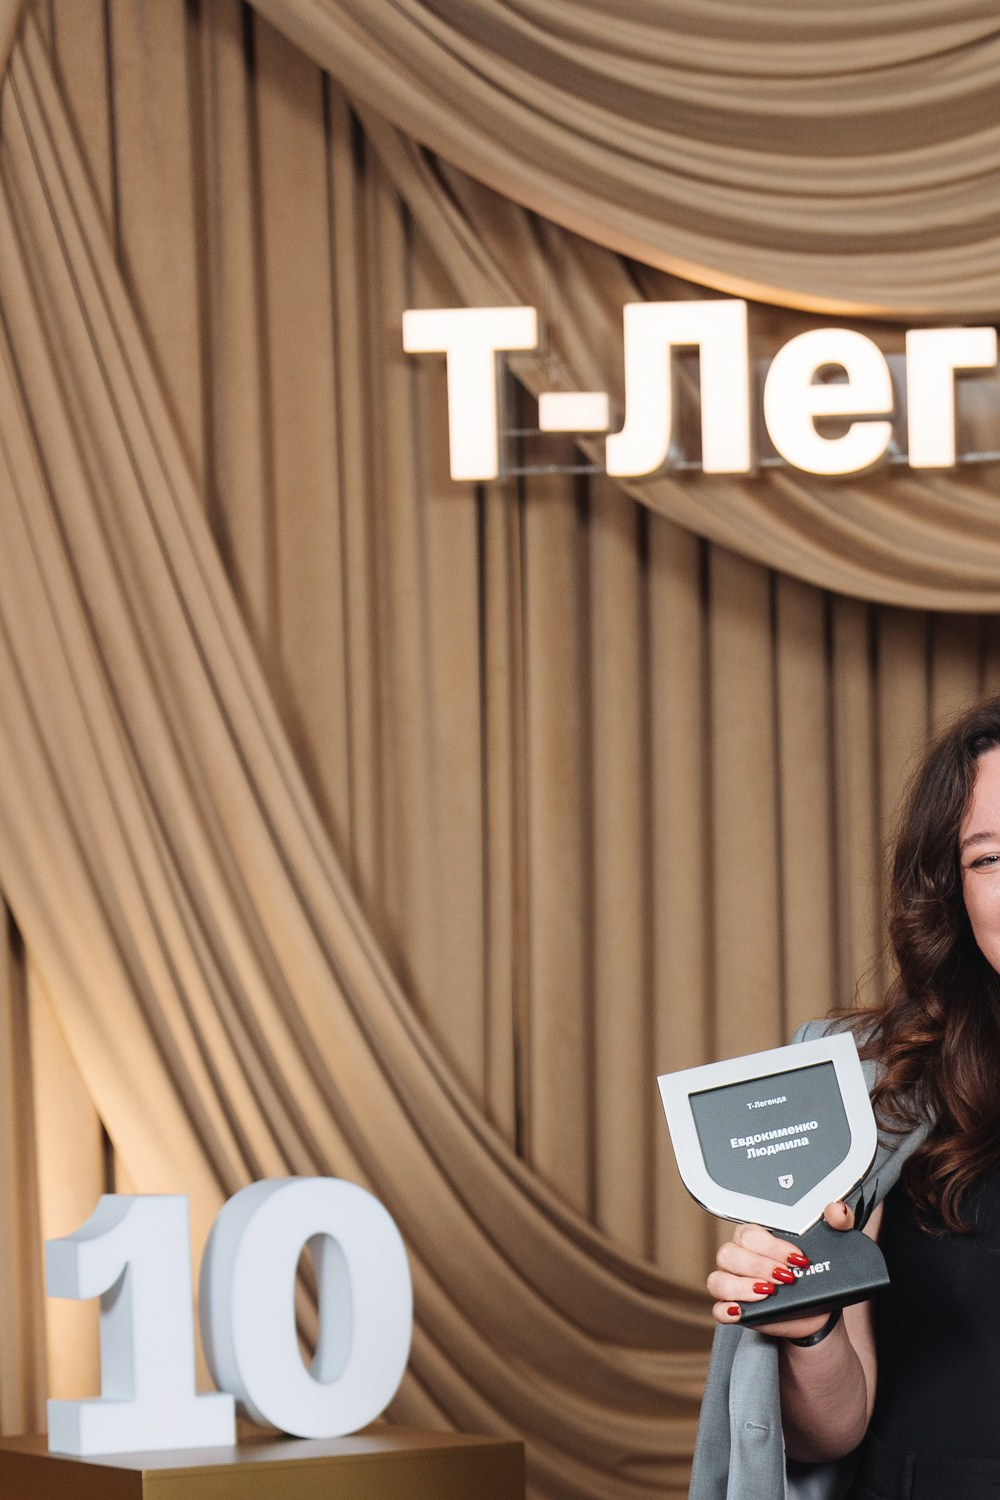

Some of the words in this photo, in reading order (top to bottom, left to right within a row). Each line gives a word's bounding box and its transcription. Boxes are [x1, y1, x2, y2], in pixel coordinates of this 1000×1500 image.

[746, 1095, 787, 1110] Т-Легенда
[730, 1120, 819, 1148] Евдокименко
[746, 1137, 810, 1159] Людмила
[805, 1260, 831, 1276] лет
[45, 1176, 413, 1455] 10
